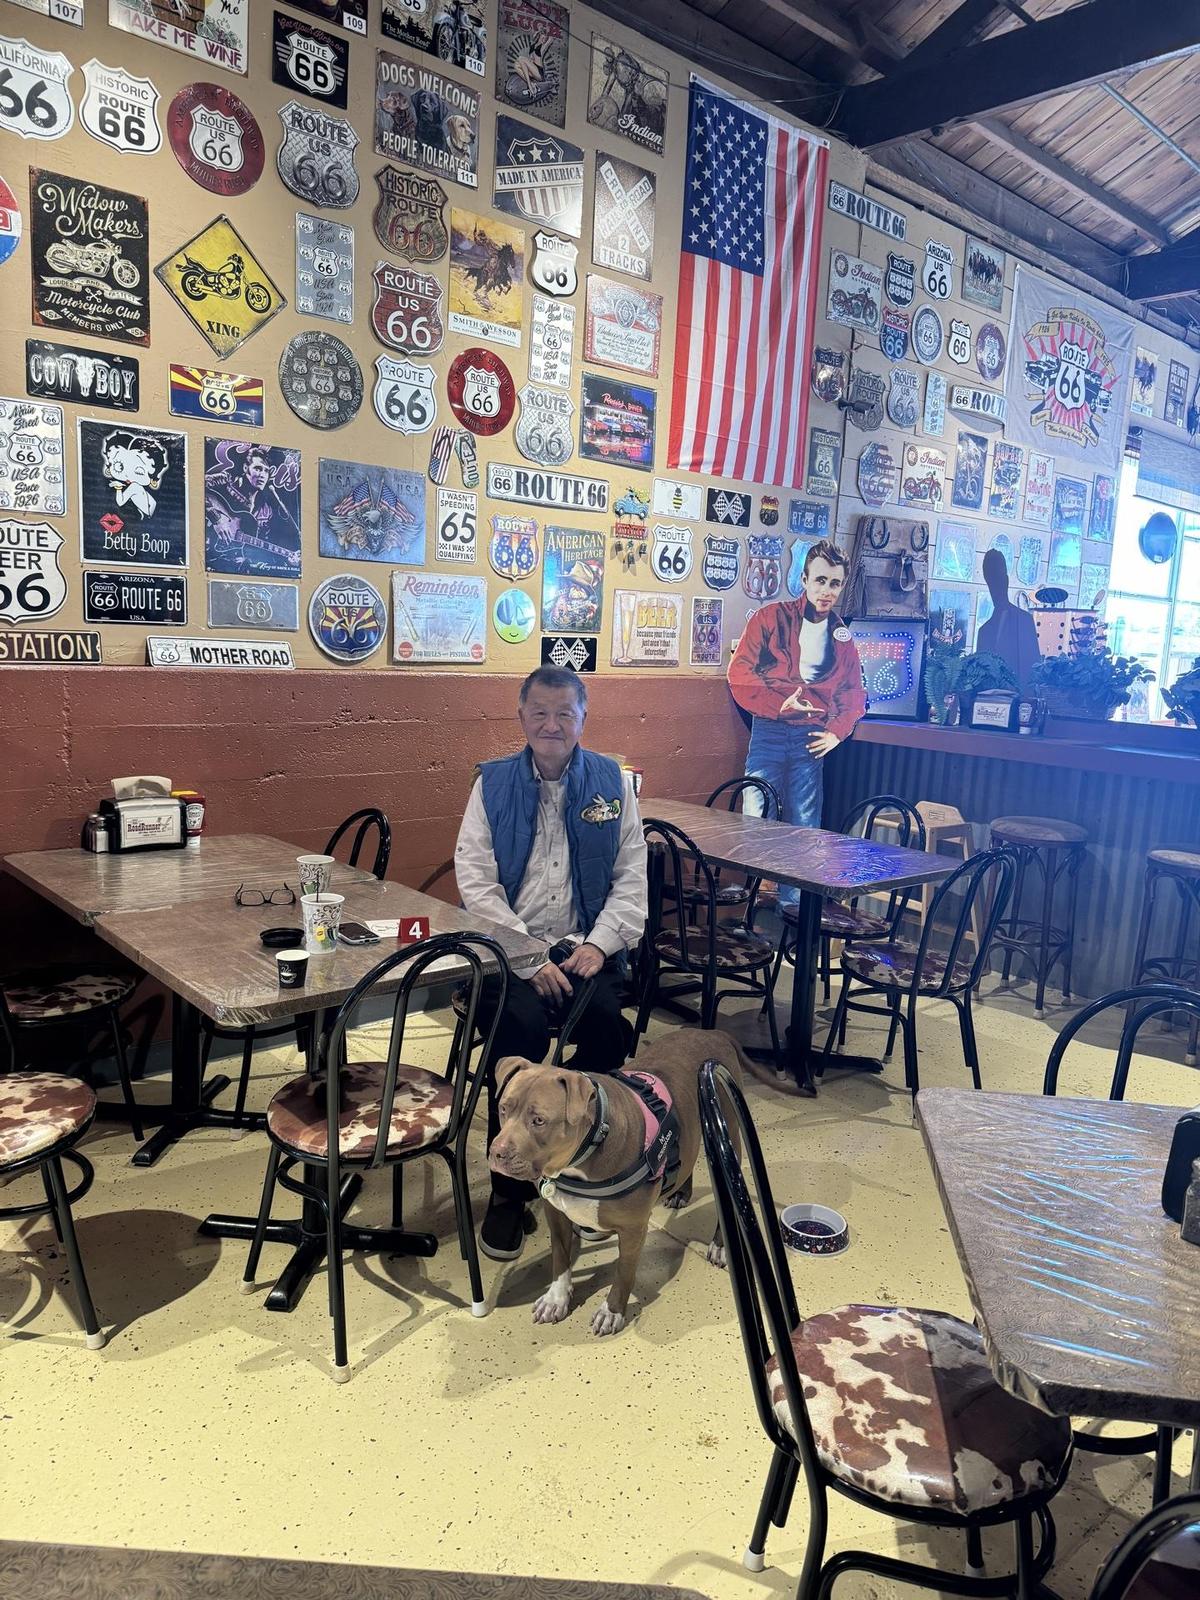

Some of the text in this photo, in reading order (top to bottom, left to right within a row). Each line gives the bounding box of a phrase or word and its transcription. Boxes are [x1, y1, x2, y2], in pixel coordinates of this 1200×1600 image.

[55, 3, 77, 20] 107
[220, 0, 240, 16] Me
[346, 15, 364, 30] 109
[117, 8, 242, 68] MAKE ME WINE
[296, 38, 328, 59] ROUTE
[295, 52, 328, 88] 66
[468, 58, 483, 72] 110
[95, 71, 150, 100] HISTORIC
[381, 61, 478, 118] DOGS WELCOME
[98, 92, 146, 119] ROUTE
[99, 106, 146, 146] 66
[200, 112, 236, 133] ROUTE
[291, 109, 348, 145] ROUTE
[617, 113, 663, 145] Indian
[209, 129, 226, 142] US
[202, 139, 233, 166] 66
[308, 137, 332, 156] US
[382, 131, 417, 160] PEOPLE
[293, 151, 347, 199] 66
[460, 171, 475, 185] 111
[497, 167, 581, 185] MADE IN AMERICA
[385, 171, 440, 203] HISTORIC
[37, 183, 129, 214] Widow
[386, 195, 437, 220] ROUTE
[833, 194, 845, 207] 66
[55, 207, 144, 239] Makers
[847, 191, 905, 239] ROUTE 66
[387, 213, 434, 257] 66
[620, 238, 627, 250] 2
[542, 237, 571, 257] ROUTE
[928, 244, 951, 261] ARIZONA
[318, 262, 333, 274] 66
[602, 248, 643, 274] TRACKS
[894, 259, 911, 272] ROUTE
[934, 261, 943, 272] US
[543, 259, 568, 288] 66
[851, 264, 881, 285] Indian
[384, 270, 434, 297] ROUTE
[928, 271, 947, 297] 66
[45, 290, 141, 320] Motorcycle Club
[398, 295, 420, 312] US
[60, 307, 125, 333] MEMBERS ONLY
[206, 320, 240, 338] XING
[452, 315, 479, 328] SMITH
[487, 322, 517, 338] WESSON
[386, 310, 432, 349] 66
[886, 326, 905, 339] ROUTE
[547, 338, 558, 348] 66
[885, 336, 903, 359] 66
[954, 339, 966, 357] 66
[1063, 345, 1086, 367] ROUTE
[30, 354, 136, 403] COW BOY
[389, 367, 425, 384] ROUTE
[470, 373, 495, 386] ROUTE
[894, 372, 917, 387] ROUTE
[1059, 365, 1080, 403] 66
[315, 379, 331, 392] 66
[477, 385, 488, 393] US
[206, 391, 231, 411] 66
[385, 384, 428, 426] 66
[472, 393, 493, 413] 66
[527, 390, 569, 413] ROUTE
[894, 396, 915, 417] 66
[956, 395, 968, 405] 66
[9, 404, 36, 420] Main
[538, 411, 554, 424] US
[13, 416, 40, 431] Street
[527, 426, 564, 456] 66
[16, 450, 37, 462] 66
[920, 451, 945, 467] Indian
[11, 467, 40, 481] USA
[818, 460, 830, 474] 66
[14, 482, 40, 495] Since
[493, 477, 511, 491] 66
[515, 471, 606, 508] ROUTE 66
[13, 494, 39, 508] 1926
[440, 500, 475, 511] SPEEDING
[447, 492, 474, 501] WASN'T
[440, 512, 476, 544] 65
[497, 519, 534, 533] ROUTE
[792, 512, 801, 526] RT
[817, 514, 827, 528] 66
[103, 531, 170, 559] Betty Boop
[546, 531, 604, 551] AMERICAN
[661, 531, 686, 541] ROUTE
[438, 551, 474, 560] QUALIFYING
[452, 544, 466, 552] WAS
[493, 535, 534, 571] 66
[564, 549, 604, 562] HERITAGE
[711, 541, 734, 552] ROUTE
[659, 544, 686, 575] 66
[119, 575, 155, 583] ARIZONA
[403, 576, 480, 601] Remington
[94, 595, 115, 606] 66
[121, 586, 182, 611] ROUTE 66
[329, 592, 370, 606] ROUTE
[245, 601, 266, 617] 66
[343, 608, 358, 617] US
[637, 600, 678, 629] BEER
[331, 618, 368, 644] 66
[698, 626, 719, 643] 66
[0, 633, 92, 660] STATION
[161, 650, 175, 660] 66
[190, 647, 290, 665] MOTHER ROAD
[409, 921, 422, 939] 4
